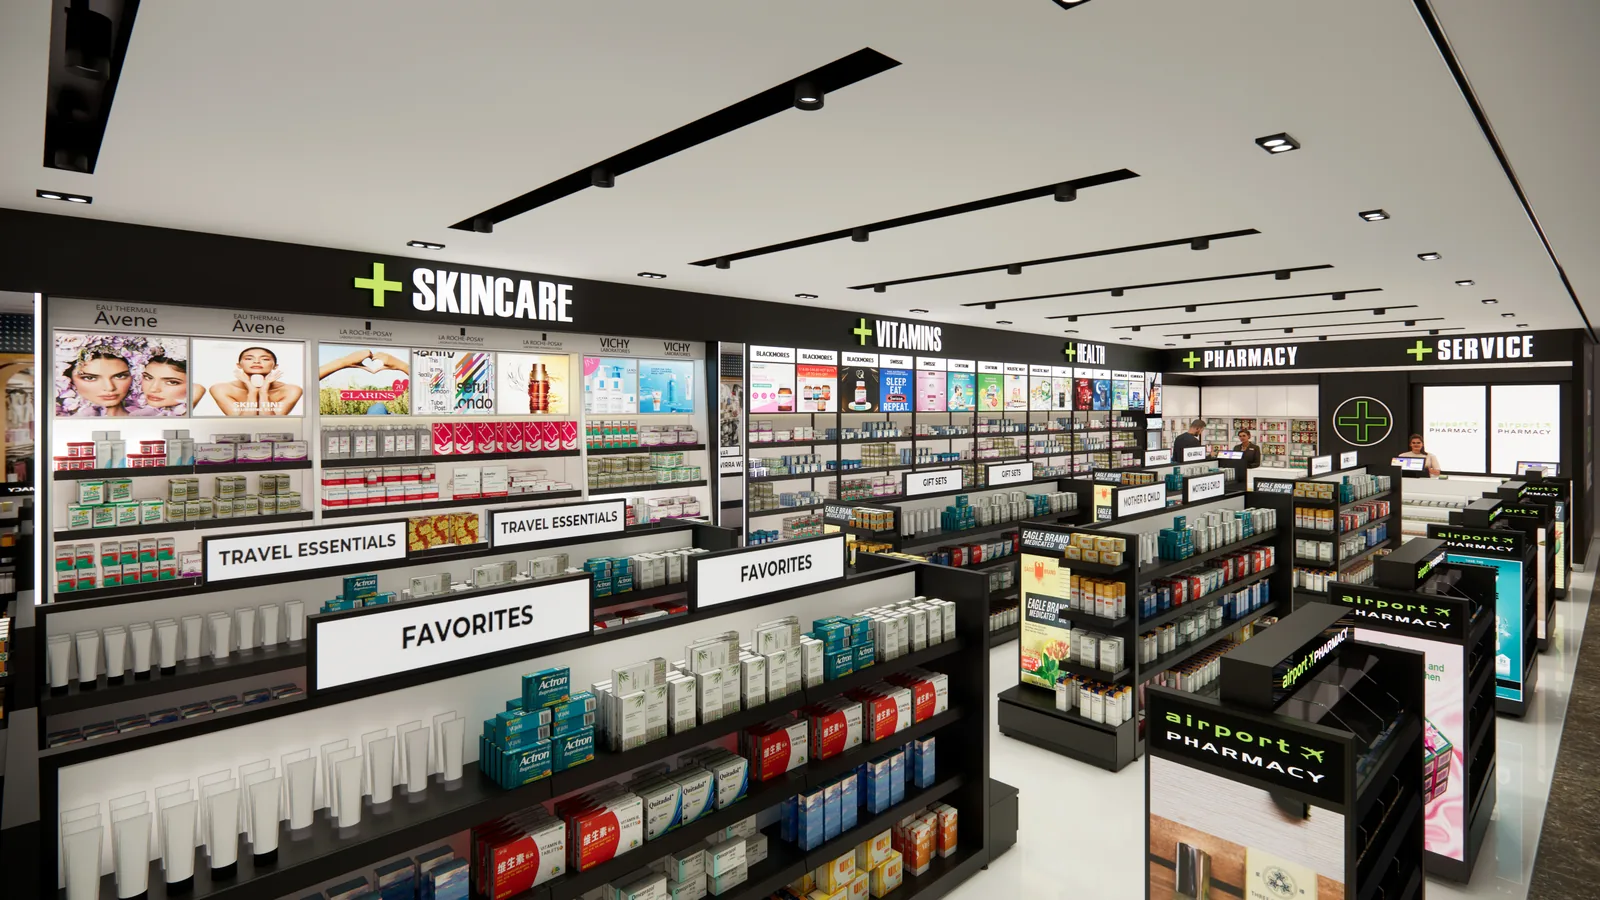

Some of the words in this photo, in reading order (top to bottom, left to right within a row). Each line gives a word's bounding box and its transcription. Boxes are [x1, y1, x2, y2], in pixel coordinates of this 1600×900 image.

[412, 267, 573, 322] SKINCARE
[96, 304, 114, 312] EAU
[115, 305, 157, 315] THERMALE
[94, 311, 158, 328] Avene
[250, 314, 284, 322] THERMALE
[232, 320, 285, 335] Avene
[348, 330, 392, 338] ROCHE-POSAY
[446, 335, 484, 343] ROCHE-POSAY
[875, 319, 942, 352] VITAMINS
[600, 338, 630, 349] VICHY
[664, 342, 691, 352] VICHY
[1437, 335, 1534, 361] SERVICE
[756, 350, 790, 358] BLACKMORES
[802, 353, 833, 361] BLACKMORES
[1077, 343, 1105, 365] HEALTH
[1203, 346, 1298, 369] PHARMACY
[885, 377, 907, 386] SLEEP.
[340, 391, 395, 399] CLARINS
[889, 386, 903, 394] EAT.
[883, 402, 910, 411] REPEAT.
[1001, 470, 1011, 478] GIFT
[1011, 469, 1021, 477] SETS
[923, 478, 934, 487] GIFT
[935, 476, 948, 486] SETS
[1192, 482, 1206, 493] MOTHER
[1210, 480, 1220, 490] CHILD
[1123, 495, 1143, 508] MOTHER
[1147, 491, 1160, 502] CHILD
[825, 505, 839, 513] EAGLE
[839, 507, 853, 516] BRAN
[501, 518, 549, 535] TRAVEL
[552, 511, 618, 529] ESSENTIALS
[1022, 530, 1044, 541] EAGLE
[1044, 533, 1070, 544] BRAND
[1024, 539, 1054, 548] MEDICATED
[1437, 532, 1498, 544] airport
[218, 544, 293, 566] TRAVEL
[298, 534, 396, 557] ESSENTIALS
[740, 554, 812, 583] FAVORITES
[353, 580, 376, 588] Actron
[1027, 597, 1047, 610] EAGLE
[1341, 594, 1428, 614] airport
[1028, 609, 1056, 622] MEDICATED
[402, 605, 533, 650] FAVORITES
[1282, 655, 1308, 689] airport
[1313, 626, 1349, 664] PHARMACY
[1428, 663, 1445, 673] and
[538, 676, 567, 691] Actron
[1165, 710, 1290, 755] airport
[564, 736, 593, 752] Actron
[519, 750, 550, 768] Actron
[1166, 730, 1325, 784] PHARMACY
[719, 767, 740, 781] Quitadol
[683, 781, 705, 796] Quitadol
[648, 794, 672, 810] Quitadol
[540, 841, 558, 851] VITAMIN
[541, 847, 560, 857] TABLETS
